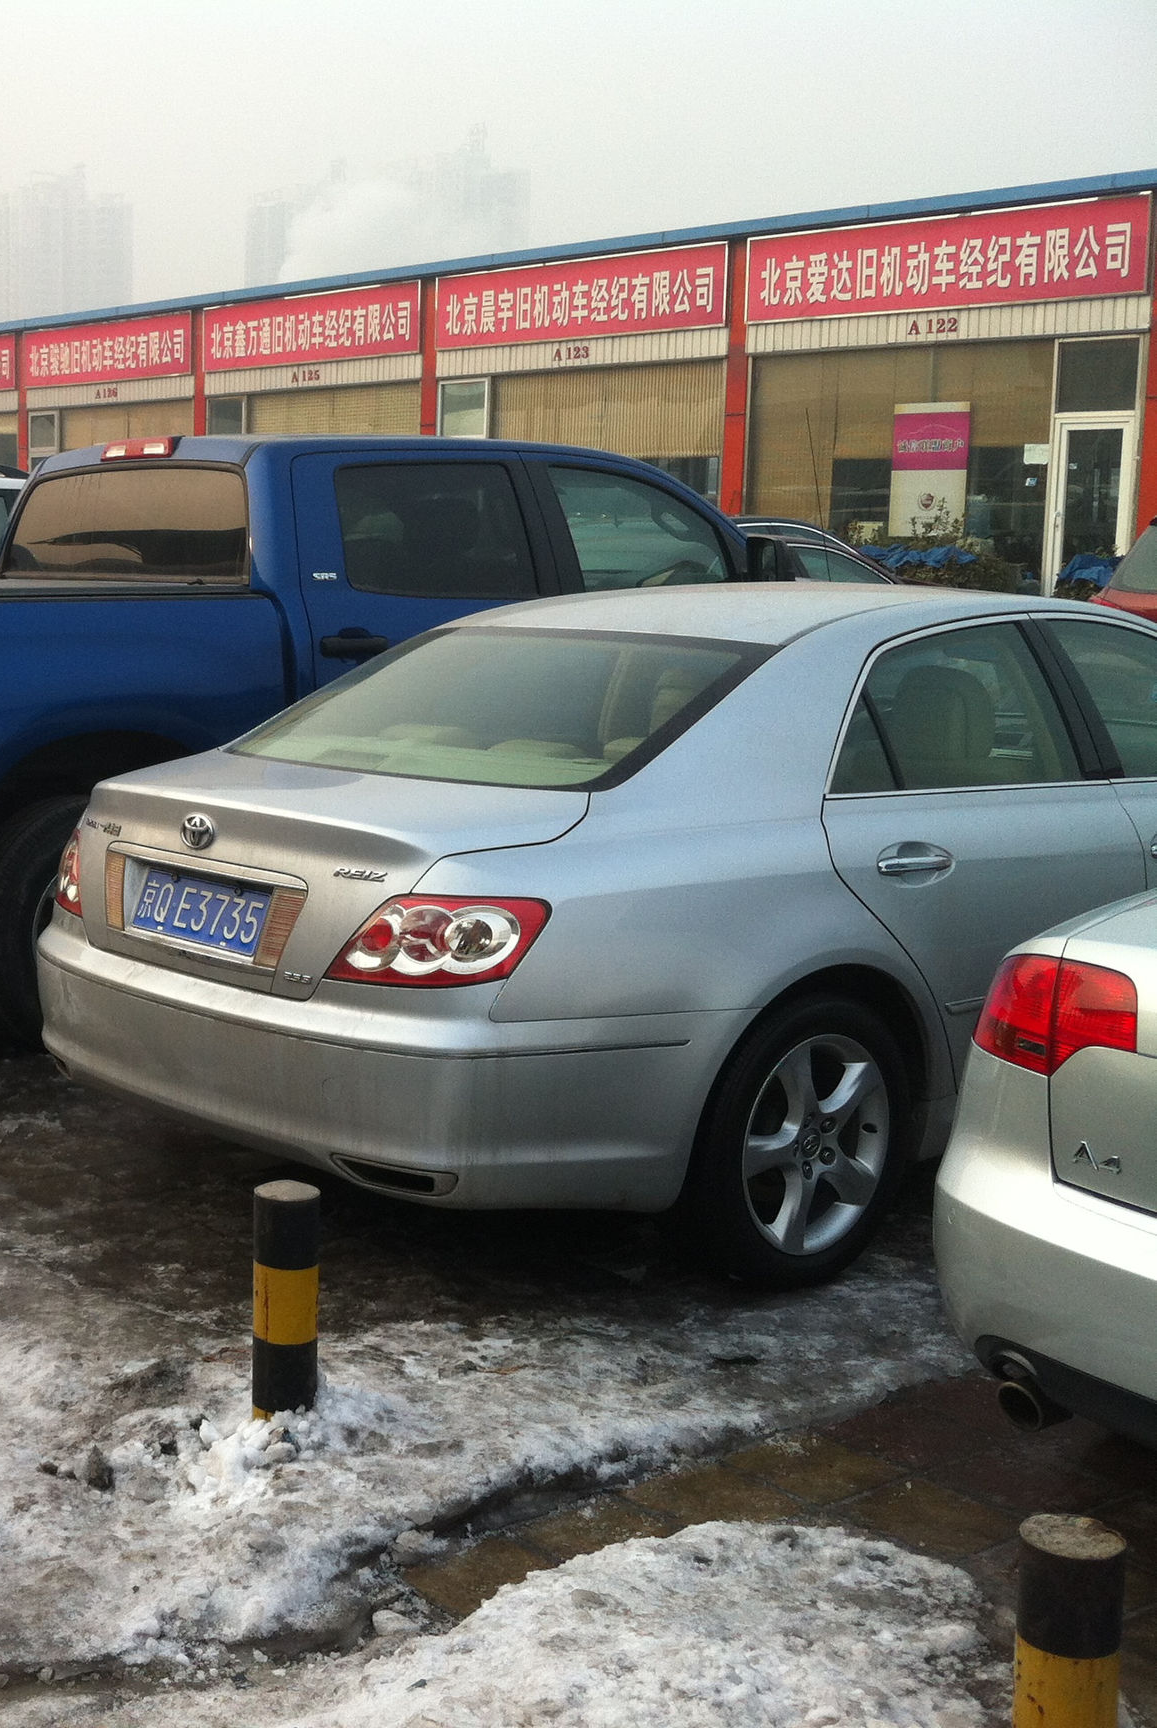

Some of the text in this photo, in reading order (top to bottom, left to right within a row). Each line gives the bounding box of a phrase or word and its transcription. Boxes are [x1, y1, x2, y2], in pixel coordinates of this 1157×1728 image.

[760, 221, 1132, 307] 北京爱达旧机动车经纪有限公司
[210, 301, 411, 360] 北京鑫万通旧机动车经纪有限公司
[445, 266, 715, 336] 北京晨宇旧机动车经纪有限公司
[333, 867, 388, 883] REIZ
[1072, 1140, 1122, 1174] A4
